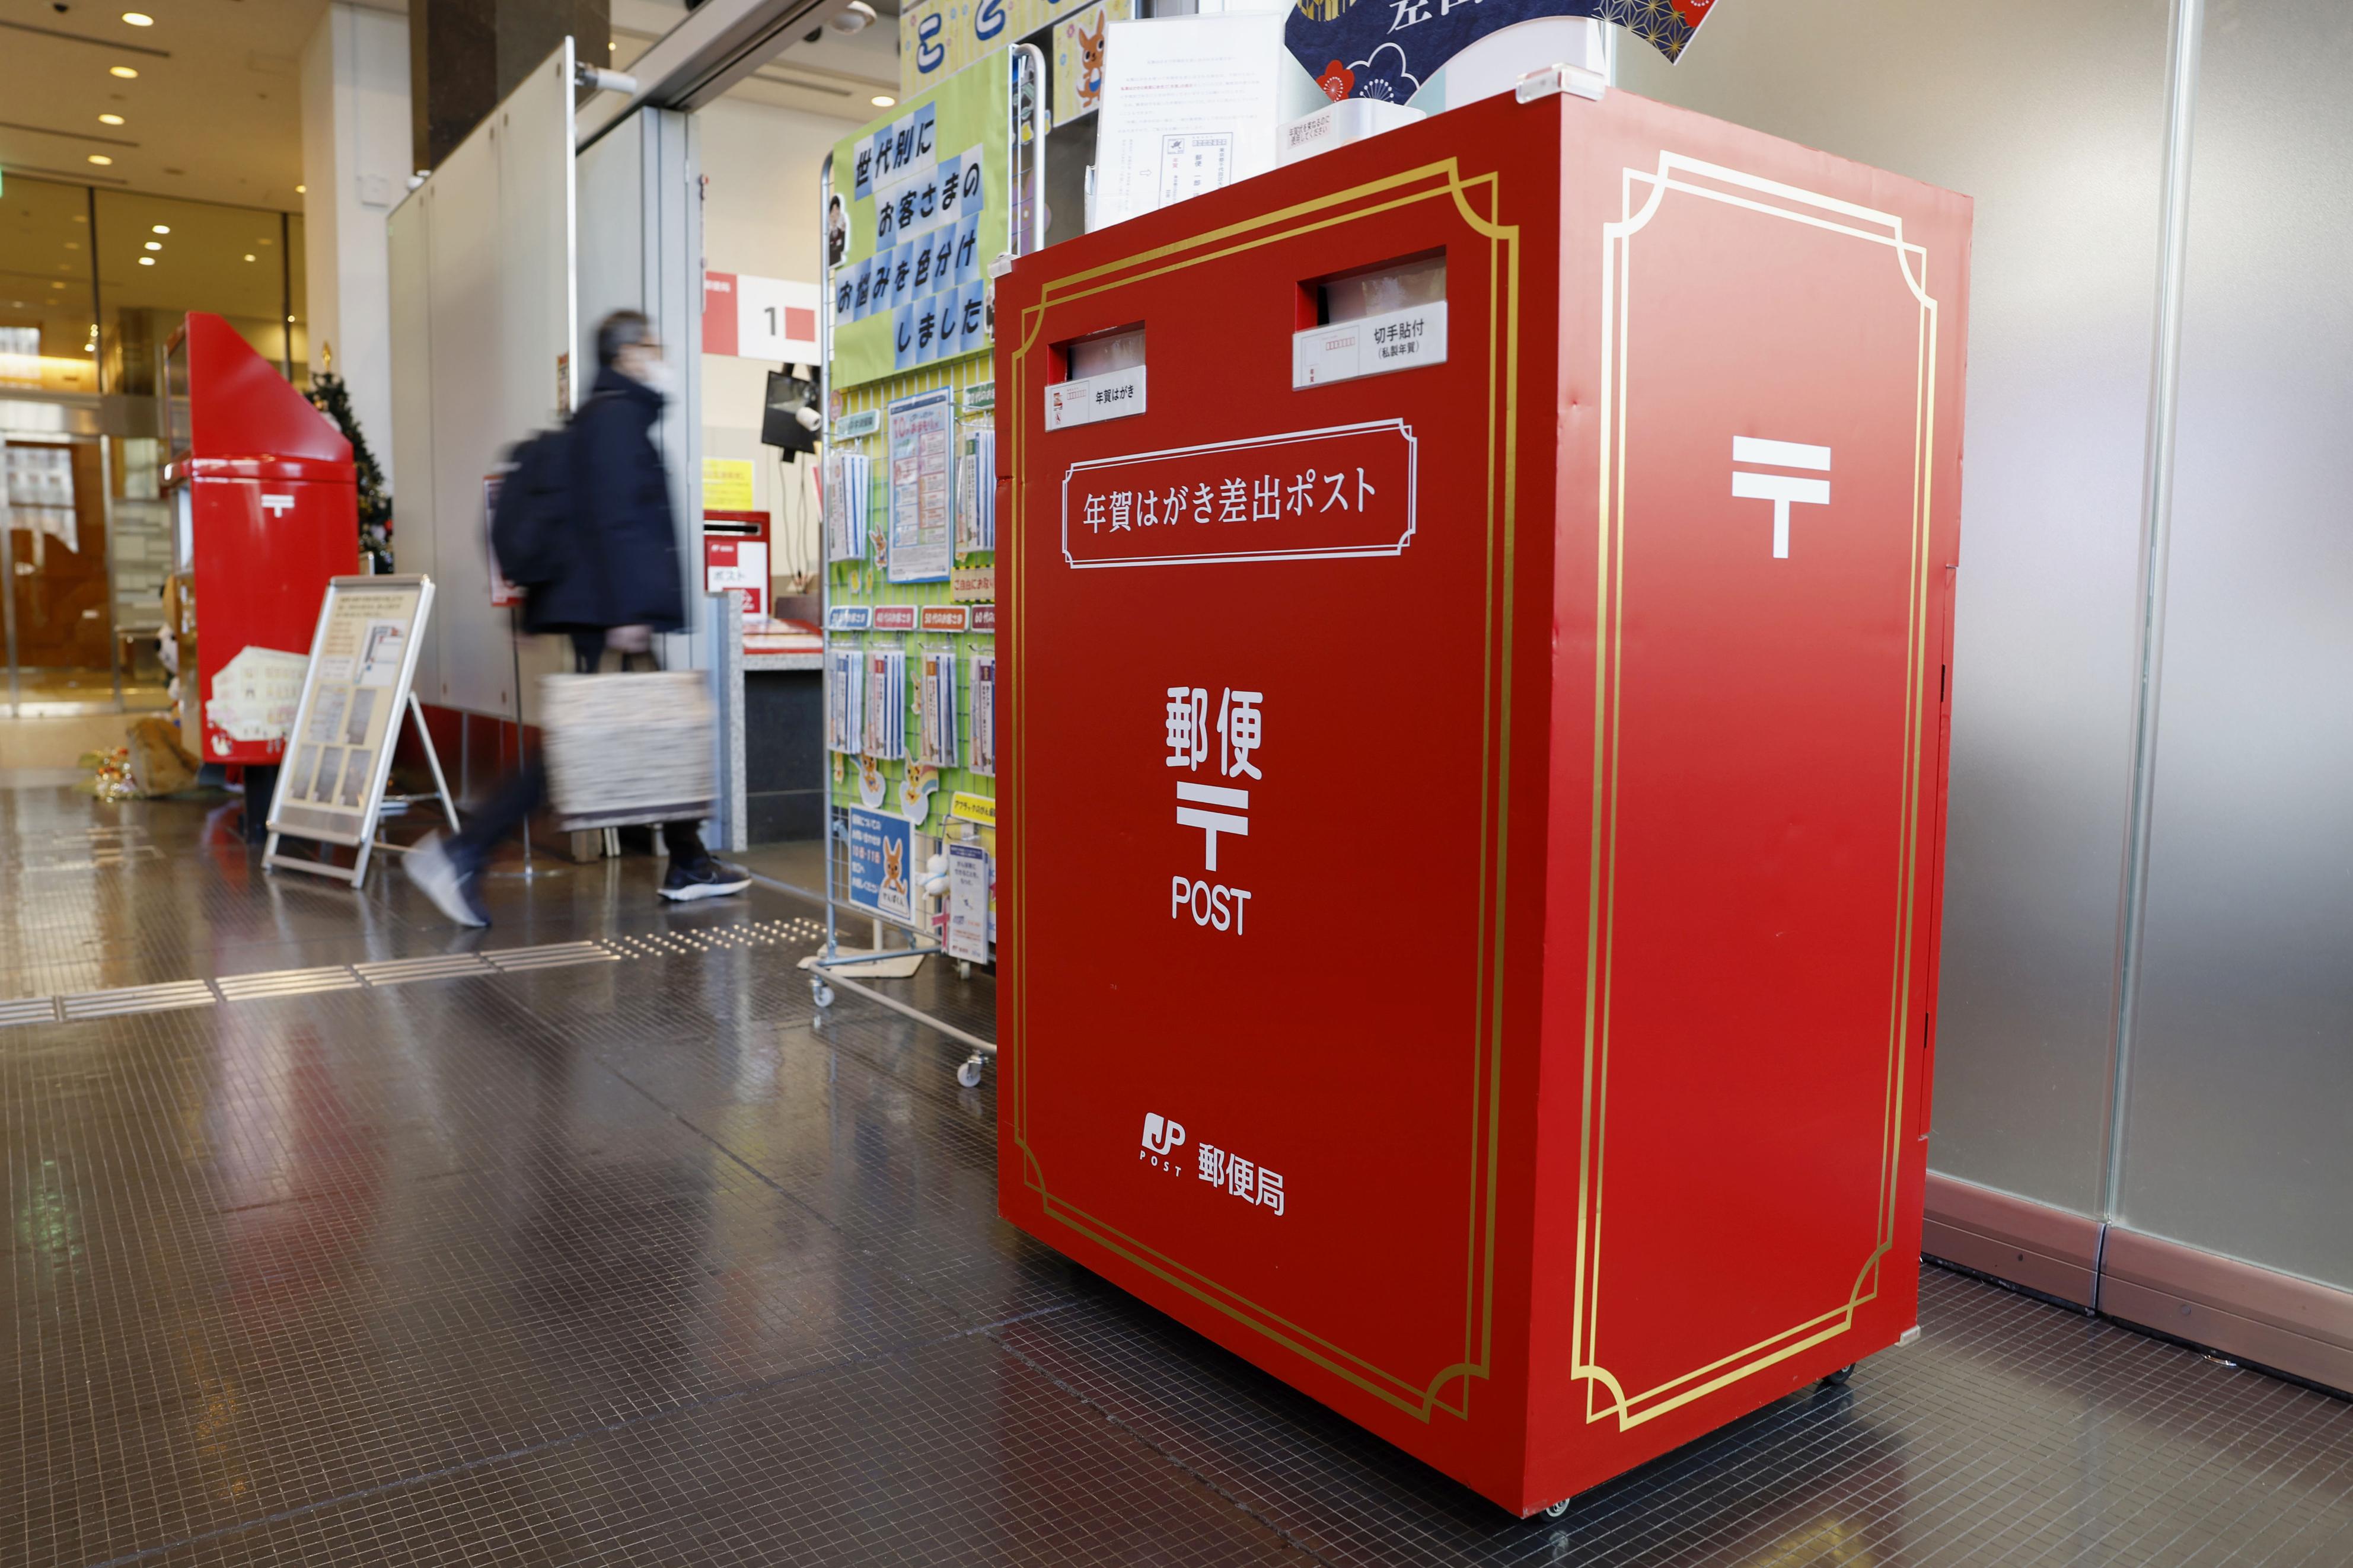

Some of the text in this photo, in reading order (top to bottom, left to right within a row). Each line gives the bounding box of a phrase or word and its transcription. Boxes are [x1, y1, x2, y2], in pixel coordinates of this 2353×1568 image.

[855, 119, 935, 188] 世代別に
[878, 164, 980, 238] お客さまの
[837, 230, 977, 313] お悩みを色分け
[764, 307, 776, 336] 1
[897, 299, 983, 353] しました
[1373, 318, 1424, 344] 切手貼付
[1378, 340, 1420, 359] (私製年賀)
[1095, 384, 1134, 404] 年賀はがき
[1082, 467, 1376, 535] 年賀はがき差出ポスト
[713, 570, 745, 581] ポスト
[1165, 685, 1264, 781] 郵便
[1172, 875, 1252, 936] POST
[1142, 1112, 1186, 1155] JP
[1139, 1150, 1182, 1177] POST
[1198, 1142, 1285, 1216] 郵便局
